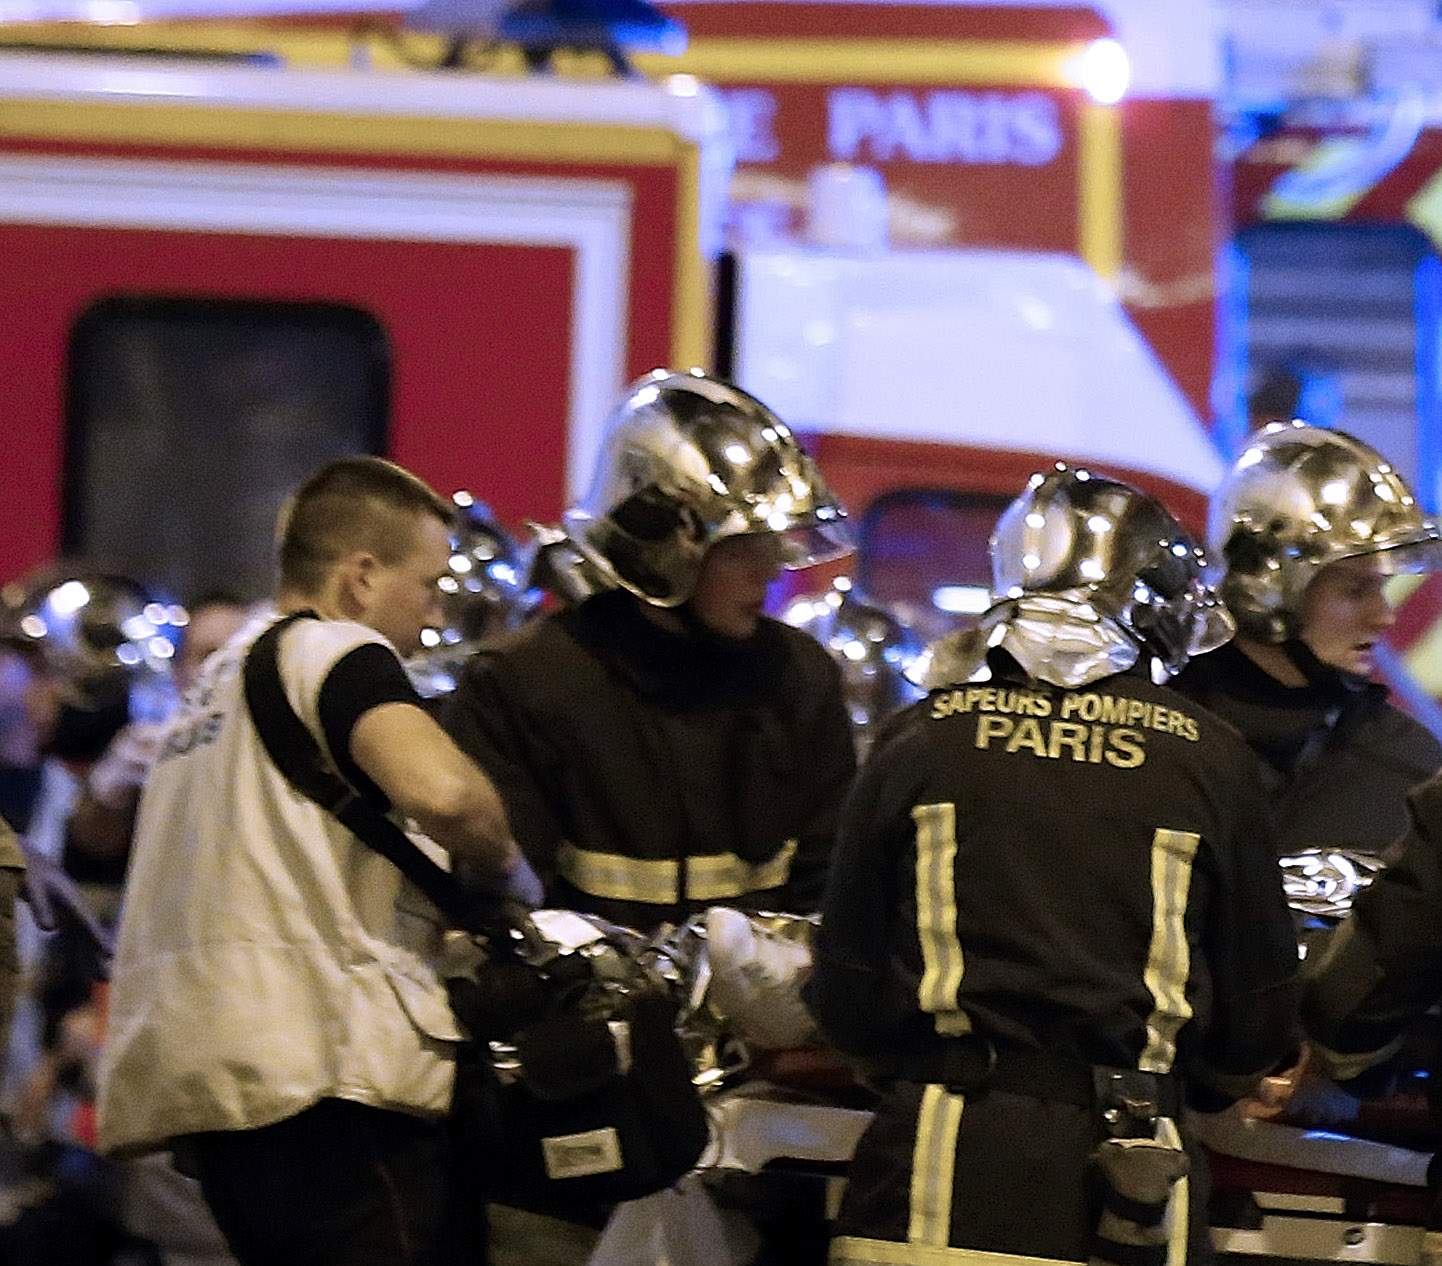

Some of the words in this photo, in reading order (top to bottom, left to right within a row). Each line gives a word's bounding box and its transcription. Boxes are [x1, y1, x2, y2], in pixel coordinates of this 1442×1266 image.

[827, 88, 1062, 167] PARIS
[930, 687, 1053, 720] SAPEURS
[1060, 692, 1200, 742] POMPIERS
[974, 713, 1147, 770] PARIS
